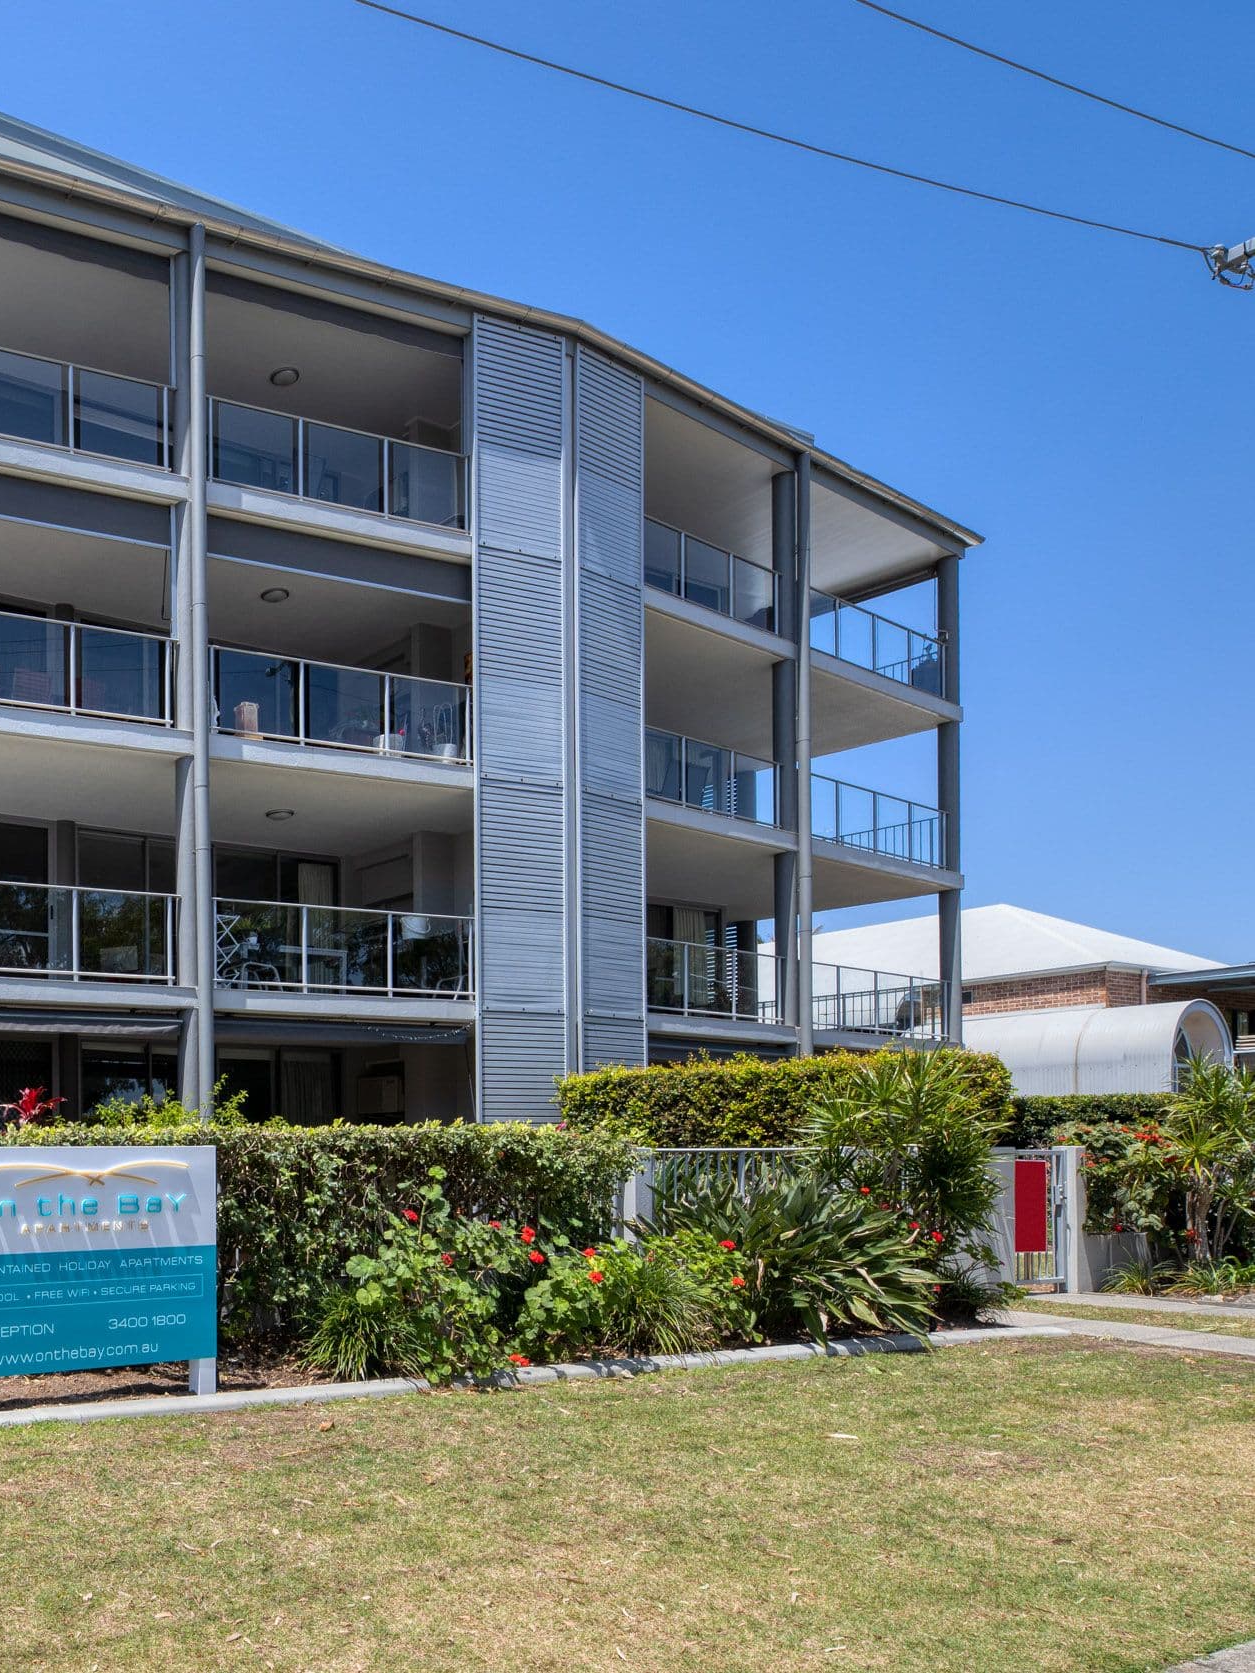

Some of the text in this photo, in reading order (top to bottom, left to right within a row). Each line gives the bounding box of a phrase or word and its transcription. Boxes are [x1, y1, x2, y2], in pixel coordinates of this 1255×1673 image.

[36, 1193, 99, 1217] the
[20, 1219, 150, 1235] APARTMENTS
[58, 1259, 111, 1272] HOLIDAY
[119, 1255, 203, 1268] APARTMENTS
[34, 1289, 63, 1300] FREE
[100, 1285, 147, 1296] SECURE
[149, 1282, 196, 1293] PARKING
[108, 1313, 187, 1330] 3400 1800
